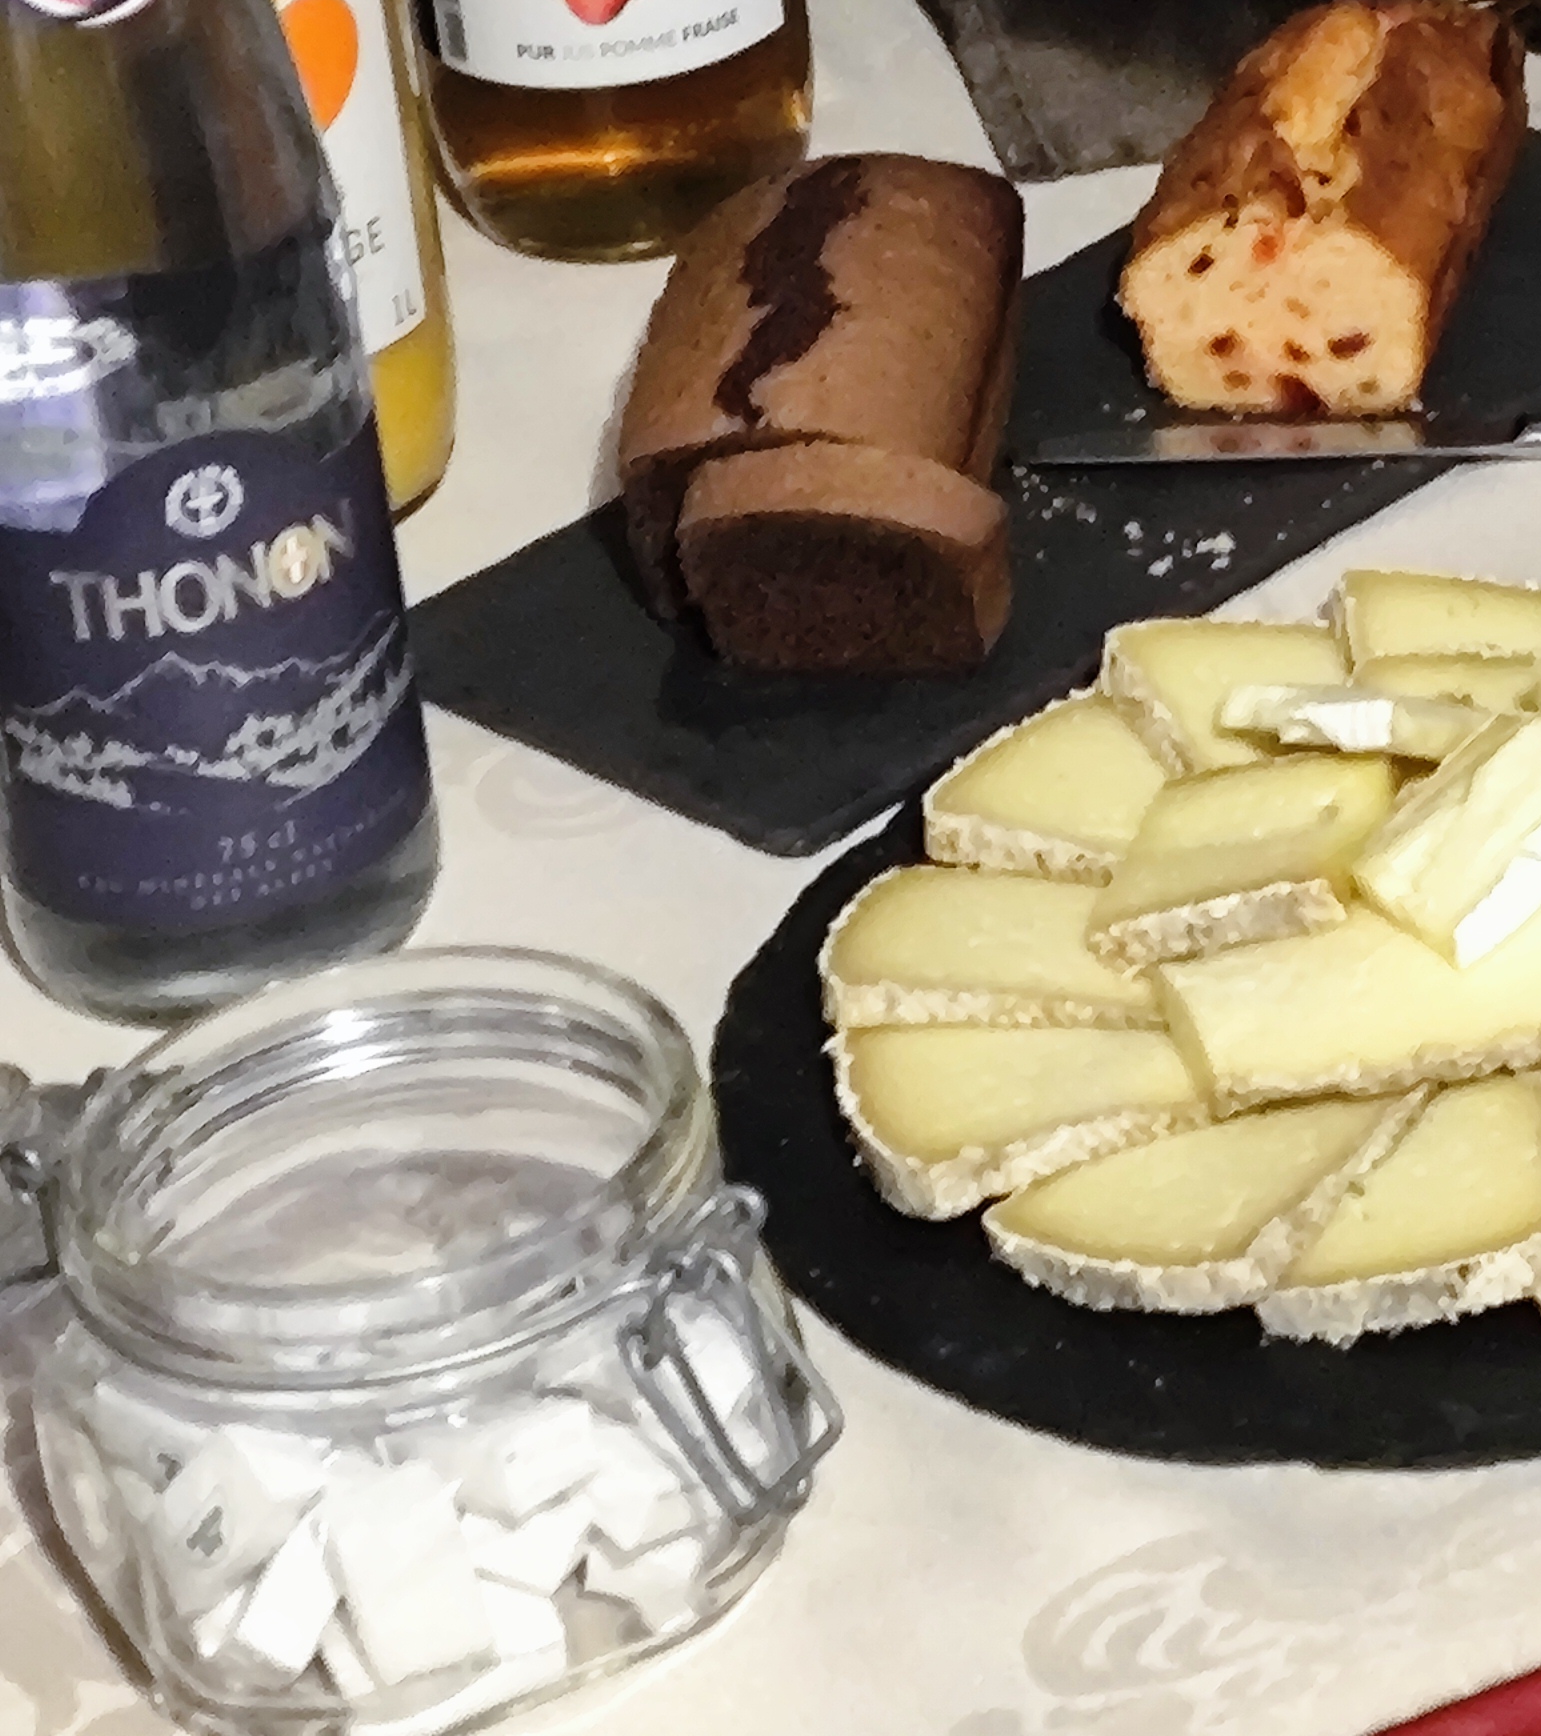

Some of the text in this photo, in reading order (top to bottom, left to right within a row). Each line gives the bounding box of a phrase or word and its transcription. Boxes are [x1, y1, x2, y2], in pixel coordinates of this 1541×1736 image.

[516, 43, 555, 60] PUR
[682, 7, 740, 41] FRAISE
[49, 497, 355, 642] THONON
